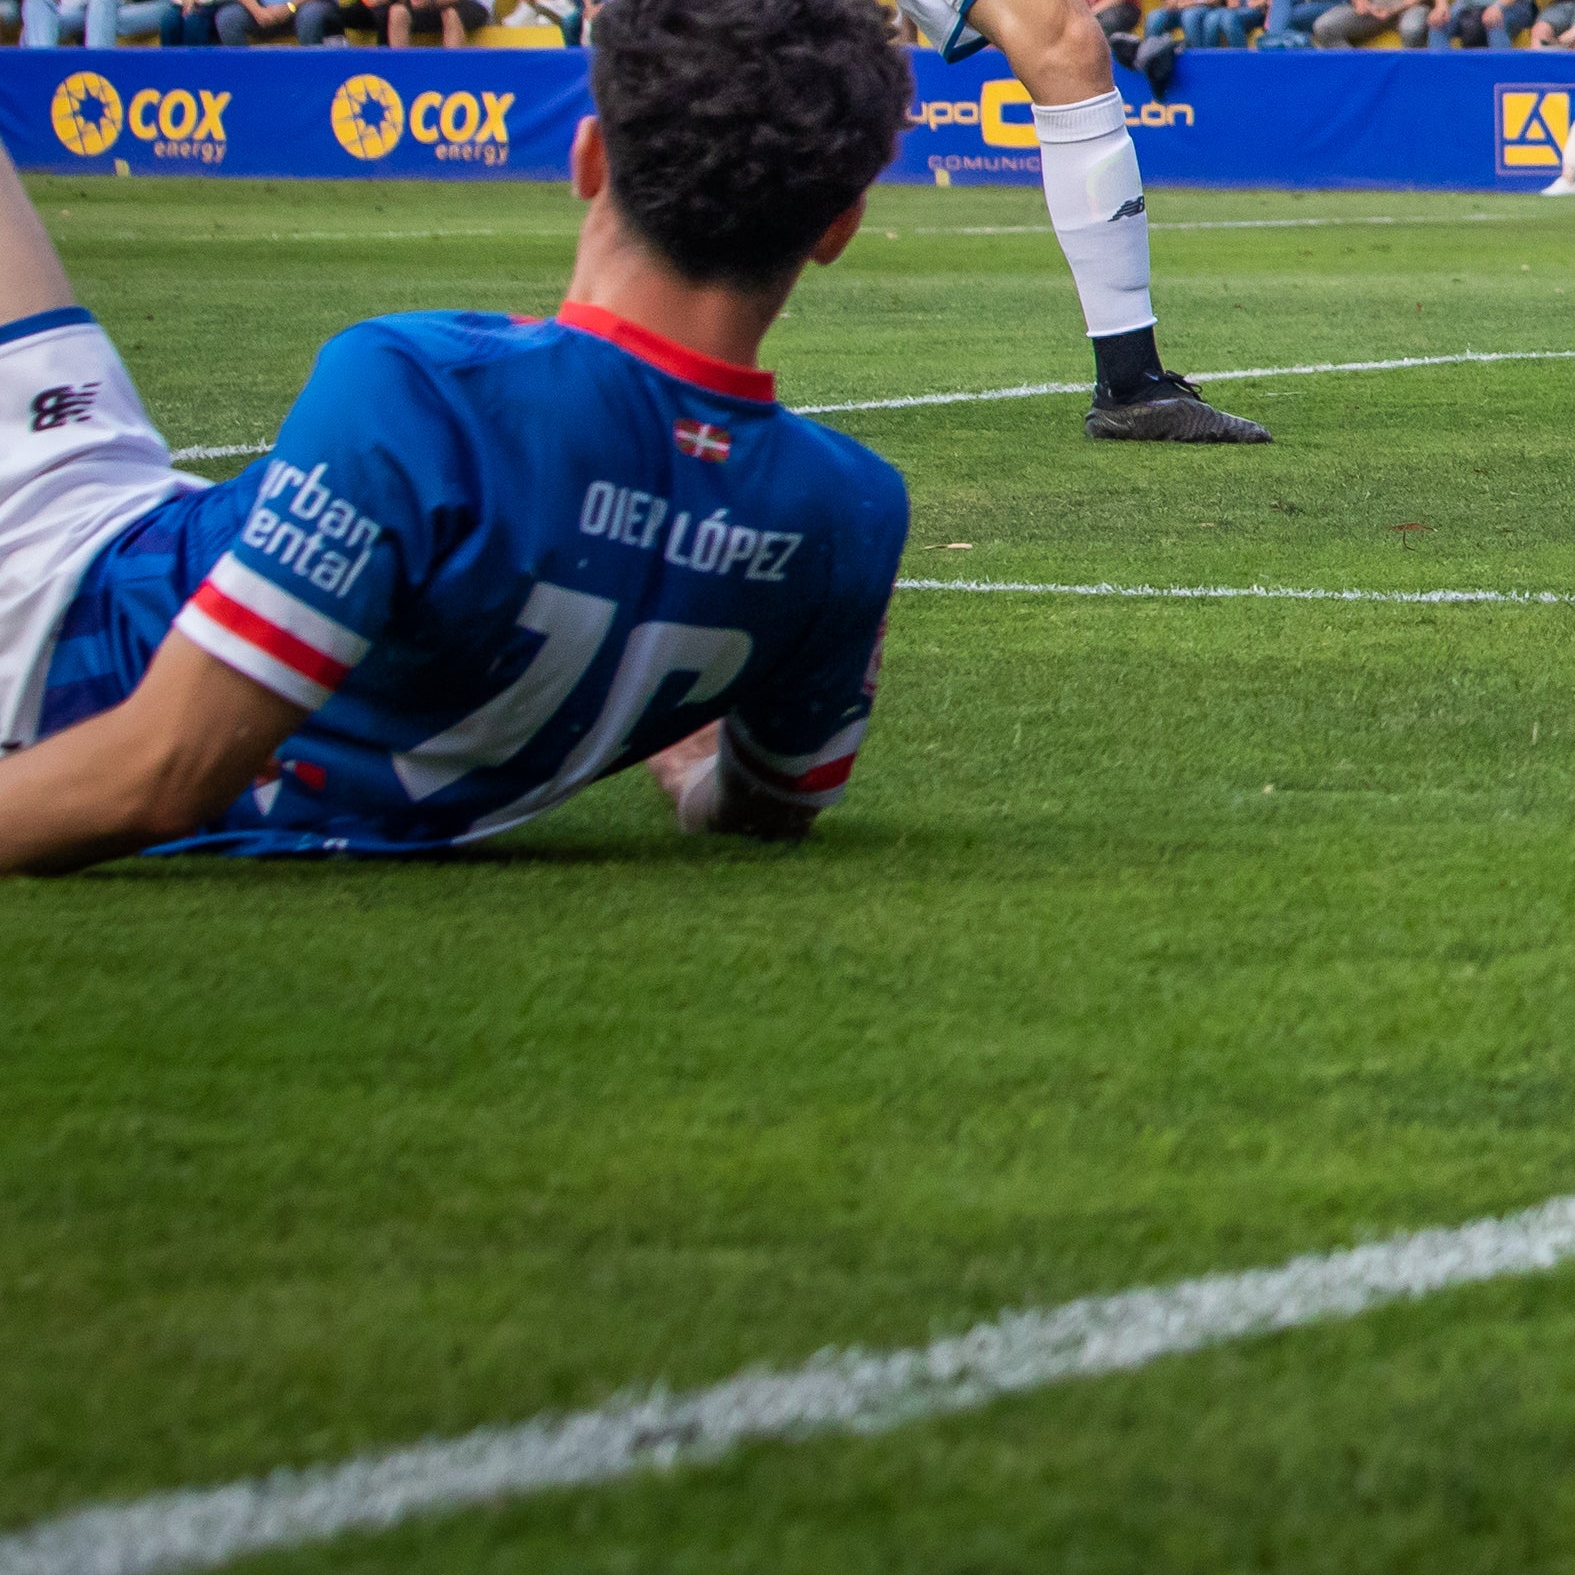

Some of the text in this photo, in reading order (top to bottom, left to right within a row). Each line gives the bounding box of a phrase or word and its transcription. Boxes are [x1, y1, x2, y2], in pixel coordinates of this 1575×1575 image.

[129, 89, 231, 141] COX
[409, 90, 515, 143] COX
[153, 140, 226, 164] energy
[434, 141, 510, 166] energy
[927, 154, 1042, 172] COMUNIC
[241, 501, 372, 599] ental
[664, 508, 804, 582] LÓPEZ
